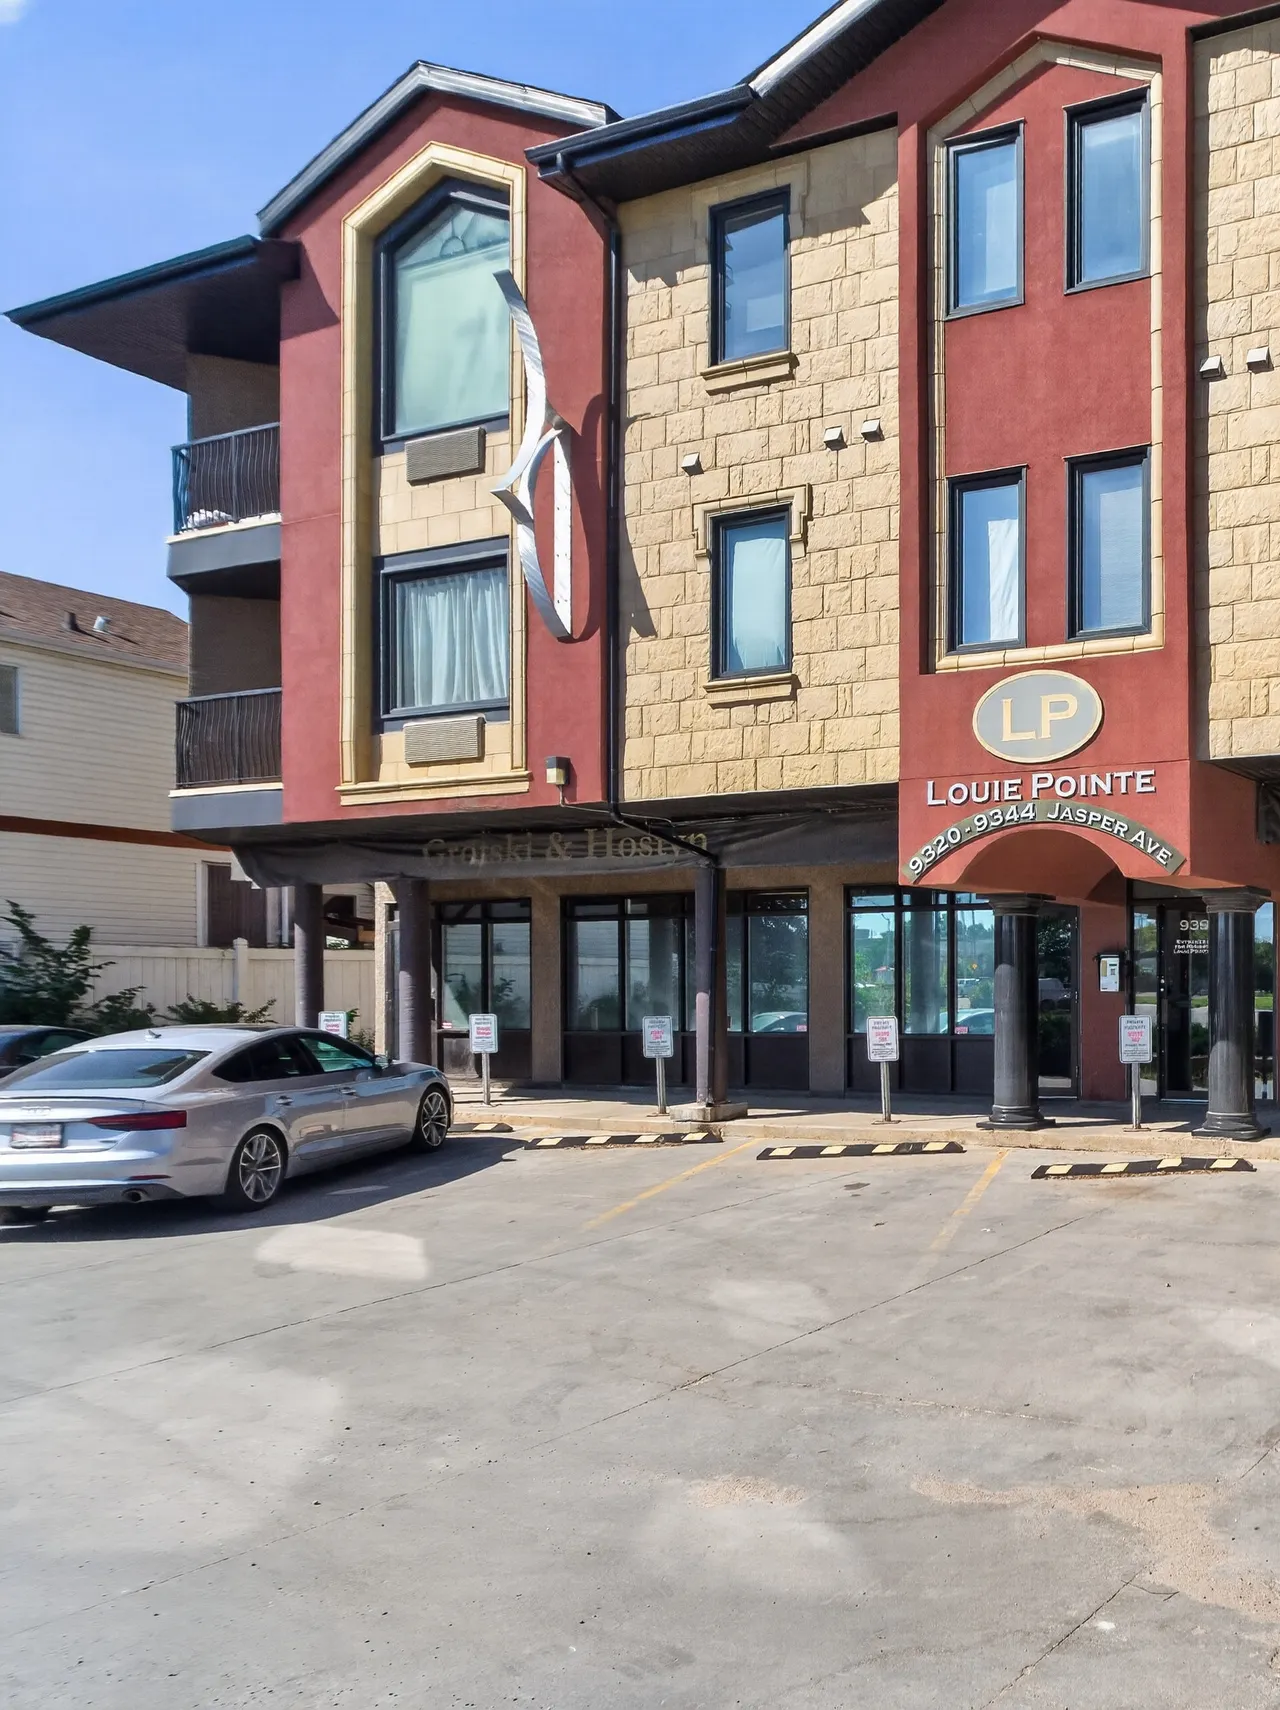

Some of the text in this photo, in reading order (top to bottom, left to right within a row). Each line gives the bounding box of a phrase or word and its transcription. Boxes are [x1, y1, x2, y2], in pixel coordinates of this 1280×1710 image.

[1001, 692, 1079, 742] LP
[926, 769, 1157, 807] LOUIE POINTE
[547, 831, 573, 862] &
[1047, 802, 1130, 838] JASPER
[1129, 830, 1174, 867] AVE
